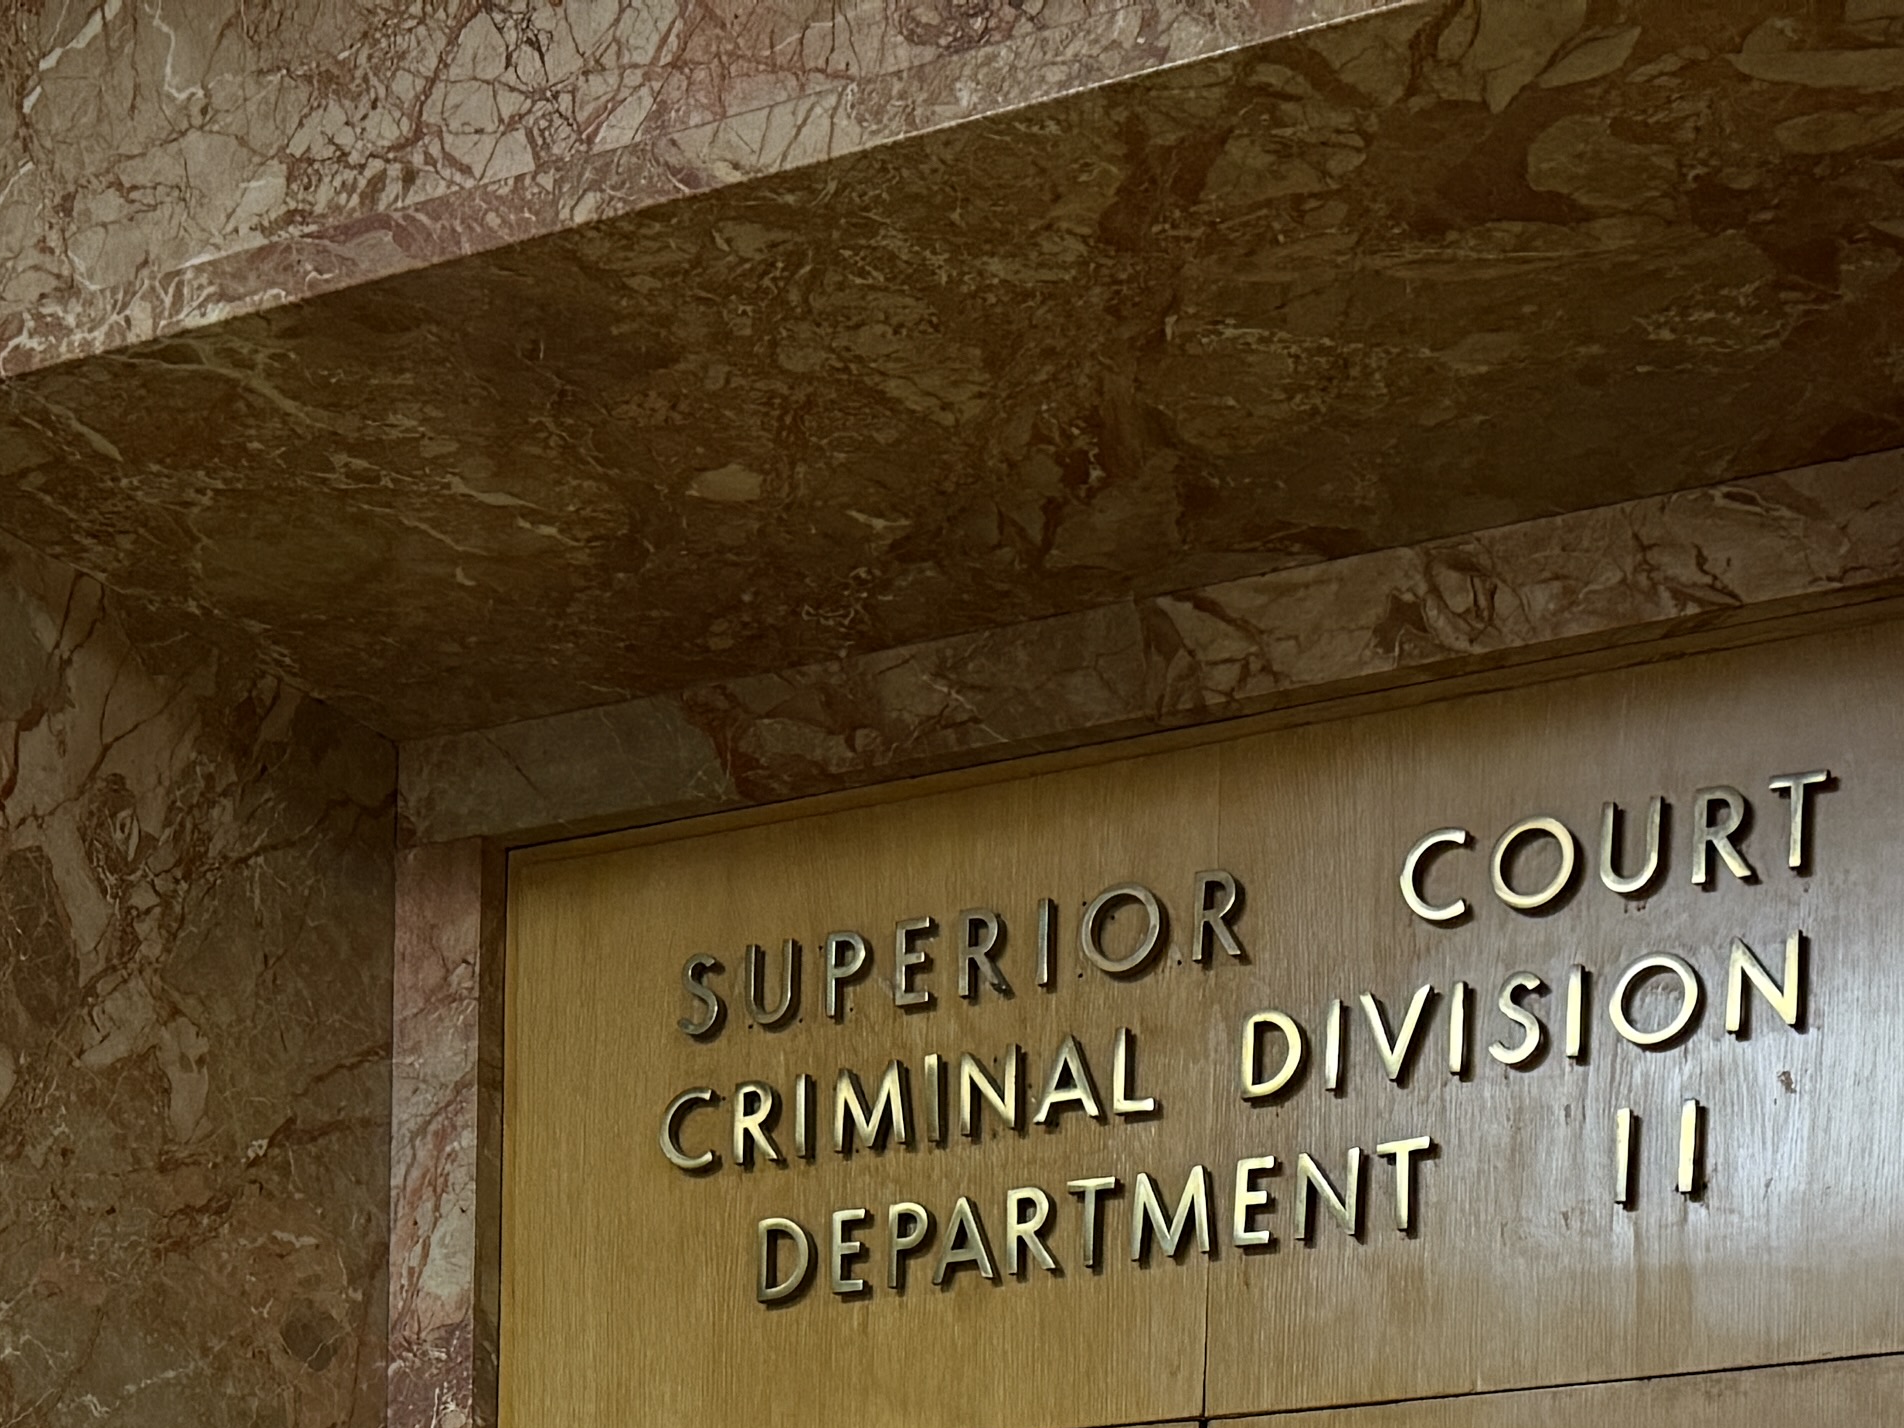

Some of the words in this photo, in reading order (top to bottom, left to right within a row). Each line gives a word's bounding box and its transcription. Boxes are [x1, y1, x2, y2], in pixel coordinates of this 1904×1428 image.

[678, 867, 1247, 1039] SUPERIOR
[1399, 767, 1835, 922] COURT
[658, 1026, 1158, 1173] CRIMINAL
[1242, 930, 1807, 1101] DIVISION
[755, 1134, 1439, 1306] DEPARTMENT
